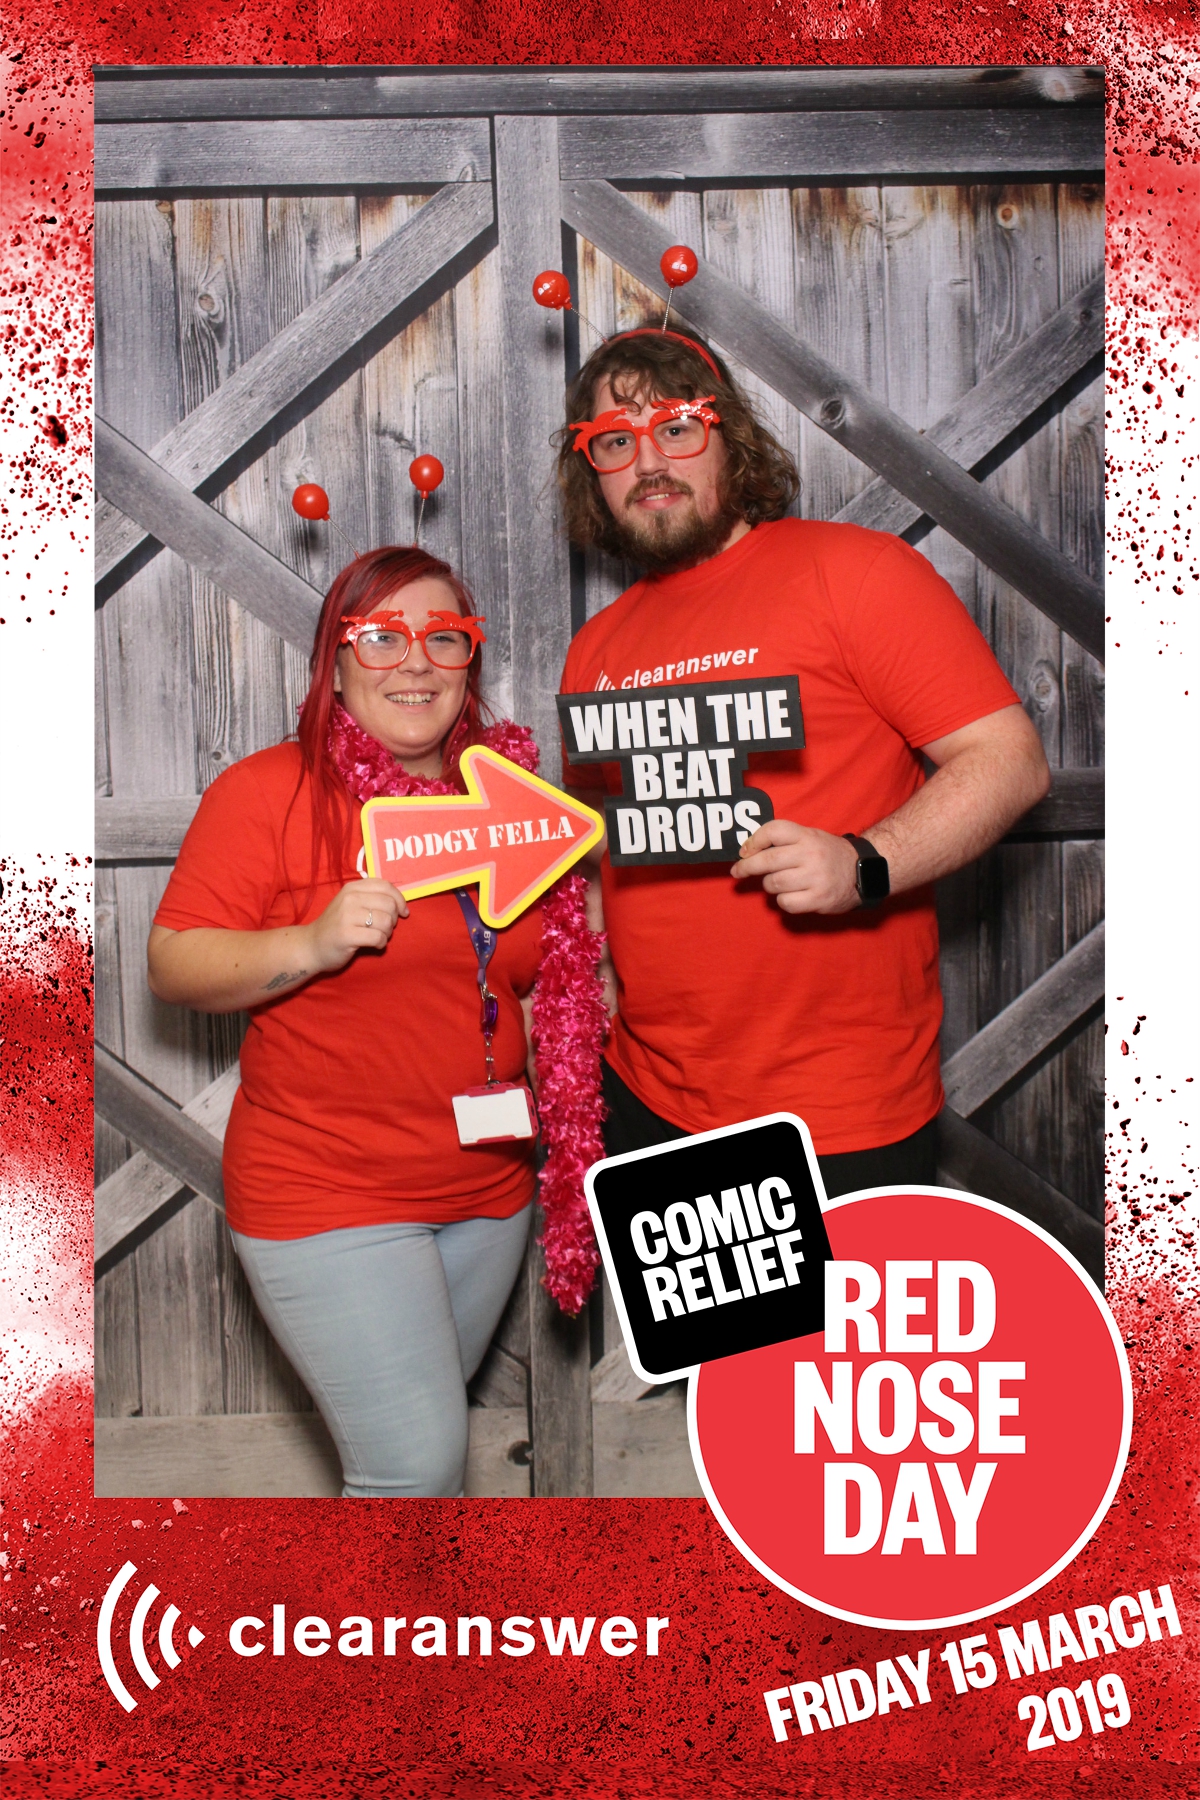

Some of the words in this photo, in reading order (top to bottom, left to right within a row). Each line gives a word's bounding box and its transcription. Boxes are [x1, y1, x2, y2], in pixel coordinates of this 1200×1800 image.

[621, 648, 759, 690] clearanswer
[569, 696, 699, 753] WHEN
[706, 689, 792, 743] THE
[631, 748, 736, 801] BEAT
[383, 827, 479, 862] DODGY
[487, 815, 575, 848] FELLA
[616, 800, 762, 854] DROPS
[483, 930, 491, 946] BT
